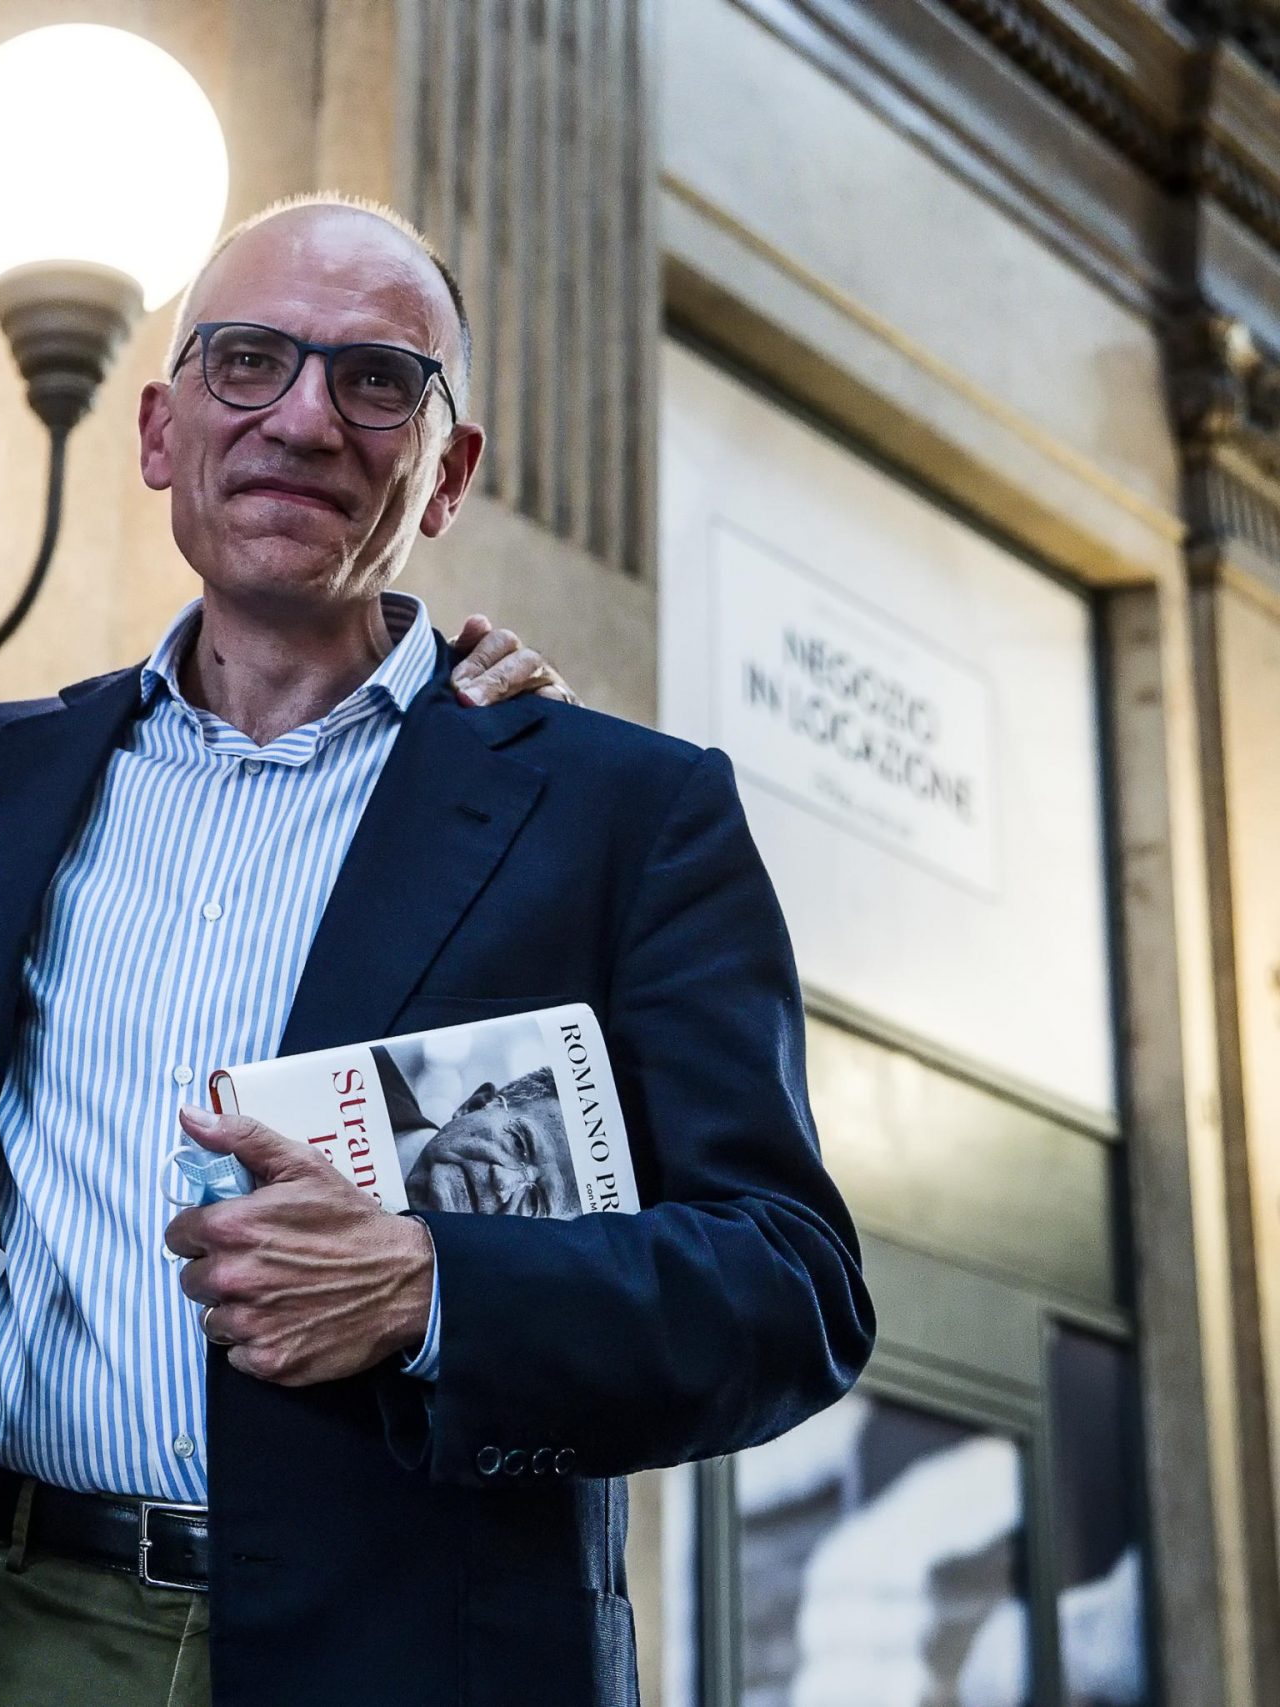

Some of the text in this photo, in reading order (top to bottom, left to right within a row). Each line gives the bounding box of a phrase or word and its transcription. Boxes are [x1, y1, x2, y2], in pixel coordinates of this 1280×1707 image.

[741, 657, 782, 715] IN
[787, 685, 975, 827] LOCAZIONE
[782, 625, 940, 744] NEGOZIO
[331, 1068, 382, 1206] Stran
[560, 1023, 610, 1163] ROMANO
[586, 1183, 595, 1201] con
